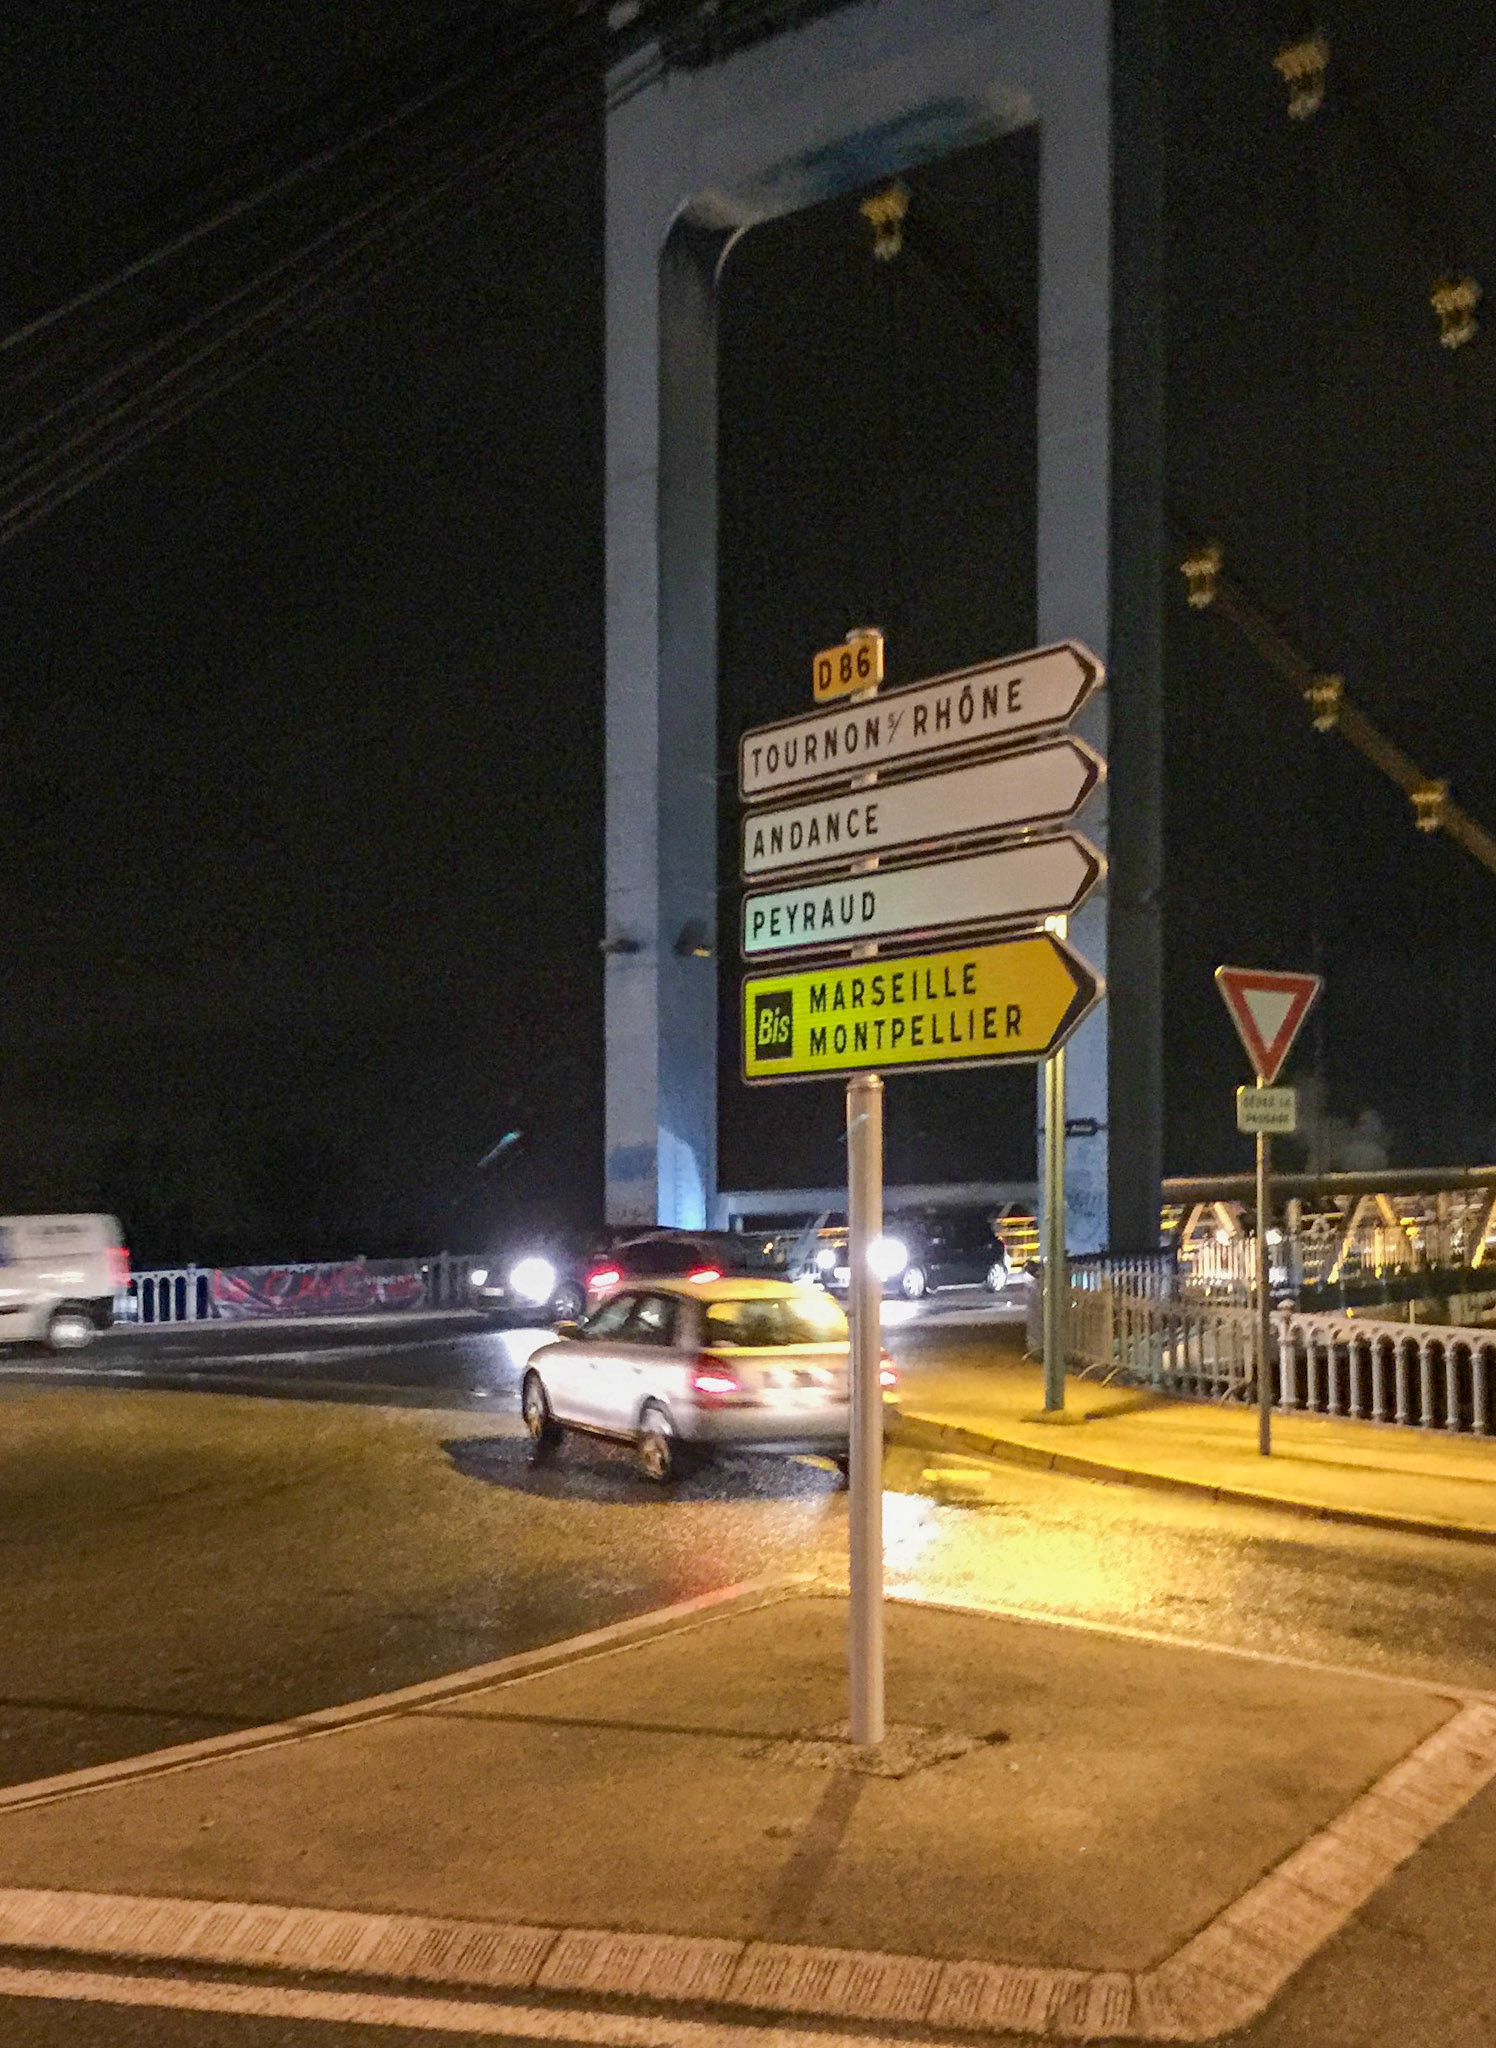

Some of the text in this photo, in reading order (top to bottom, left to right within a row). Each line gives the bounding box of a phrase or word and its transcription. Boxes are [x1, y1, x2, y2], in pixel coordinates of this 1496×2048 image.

[752, 716, 879, 777] TOURNON
[913, 679, 1022, 737] RHÔNE
[753, 804, 879, 857] ANDANCE
[753, 891, 876, 938] PEYRAUD
[810, 962, 976, 1014] MARSEILLE
[757, 1007, 790, 1045] Bis
[810, 1003, 1021, 1056] MONTPELLIER
